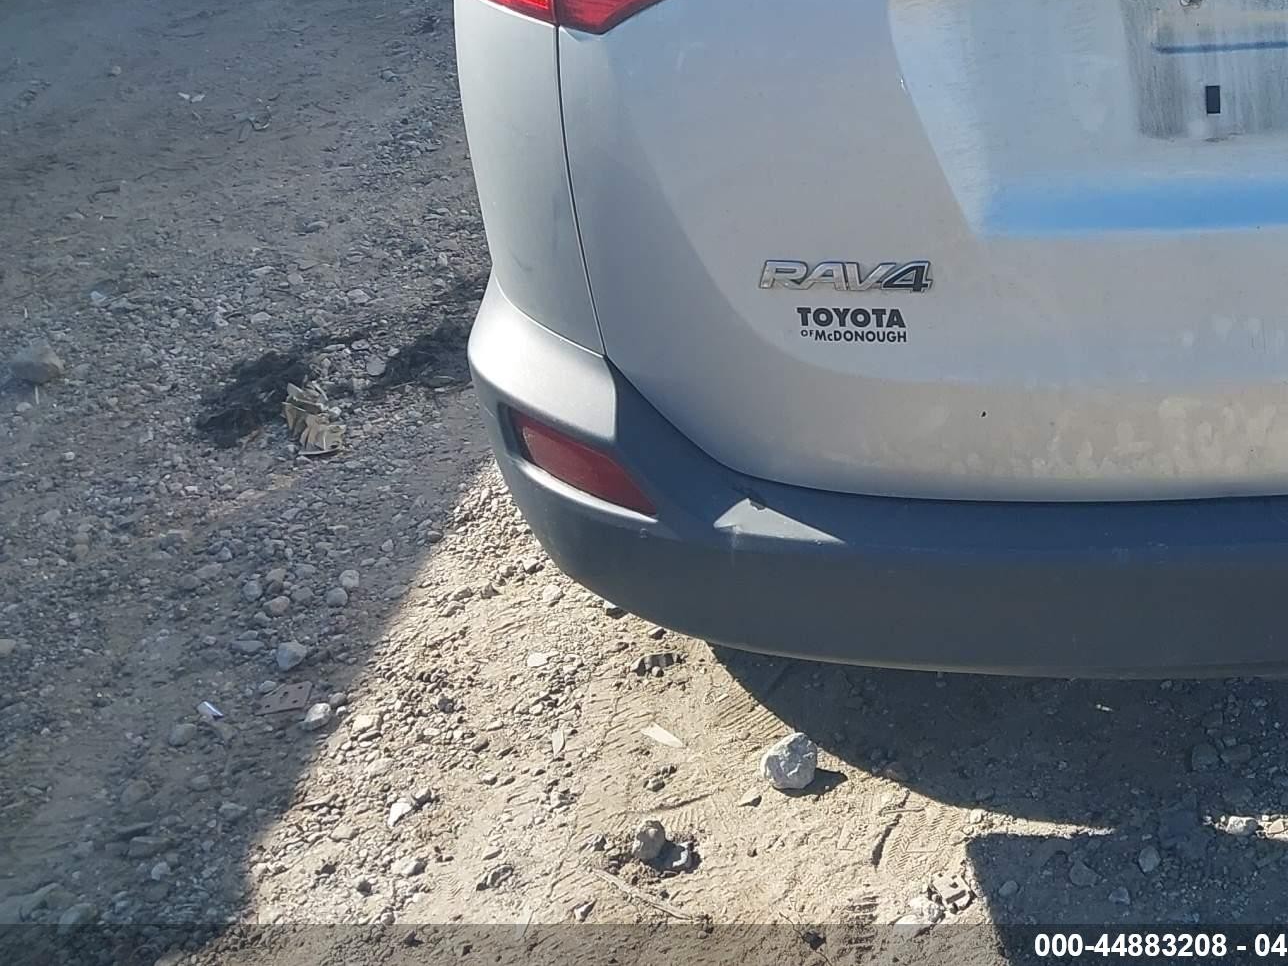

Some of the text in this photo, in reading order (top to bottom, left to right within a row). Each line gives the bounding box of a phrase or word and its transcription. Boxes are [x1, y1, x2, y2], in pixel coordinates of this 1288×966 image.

[758, 259, 935, 294] RAV4
[796, 307, 907, 328] TOYOTA
[814, 330, 908, 343] McDONOUGH
